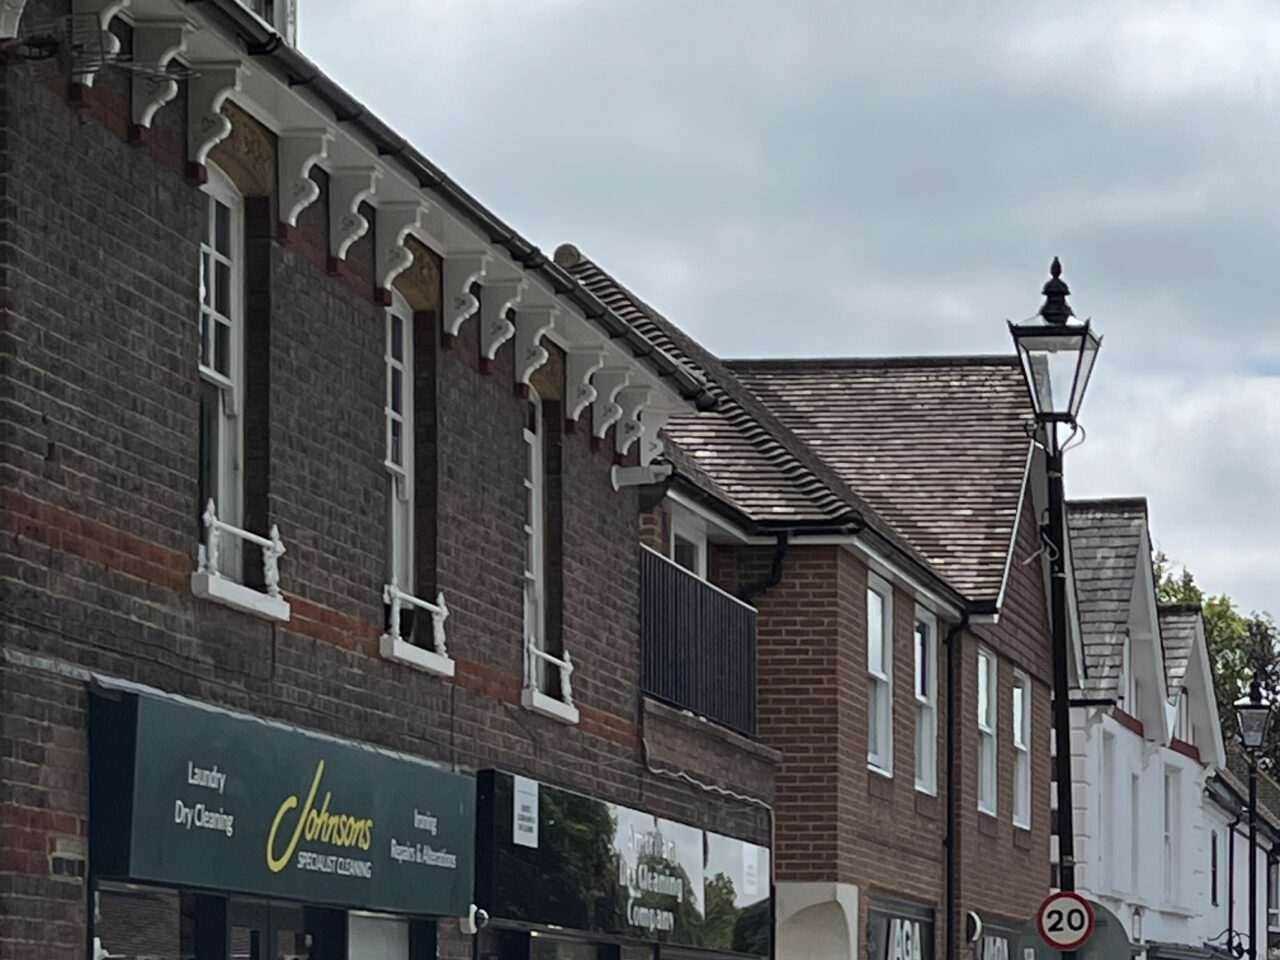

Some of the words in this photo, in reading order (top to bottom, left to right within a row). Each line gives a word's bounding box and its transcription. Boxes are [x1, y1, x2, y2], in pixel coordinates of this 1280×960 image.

[188, 761, 226, 793] Laundry
[174, 800, 193, 829] Dry
[194, 803, 234, 837] Cleaning
[266, 760, 373, 872] Johnsons
[297, 851, 337, 873] SPECIALIST
[337, 857, 372, 878] CLEANING
[1046, 908, 1085, 932] 20
